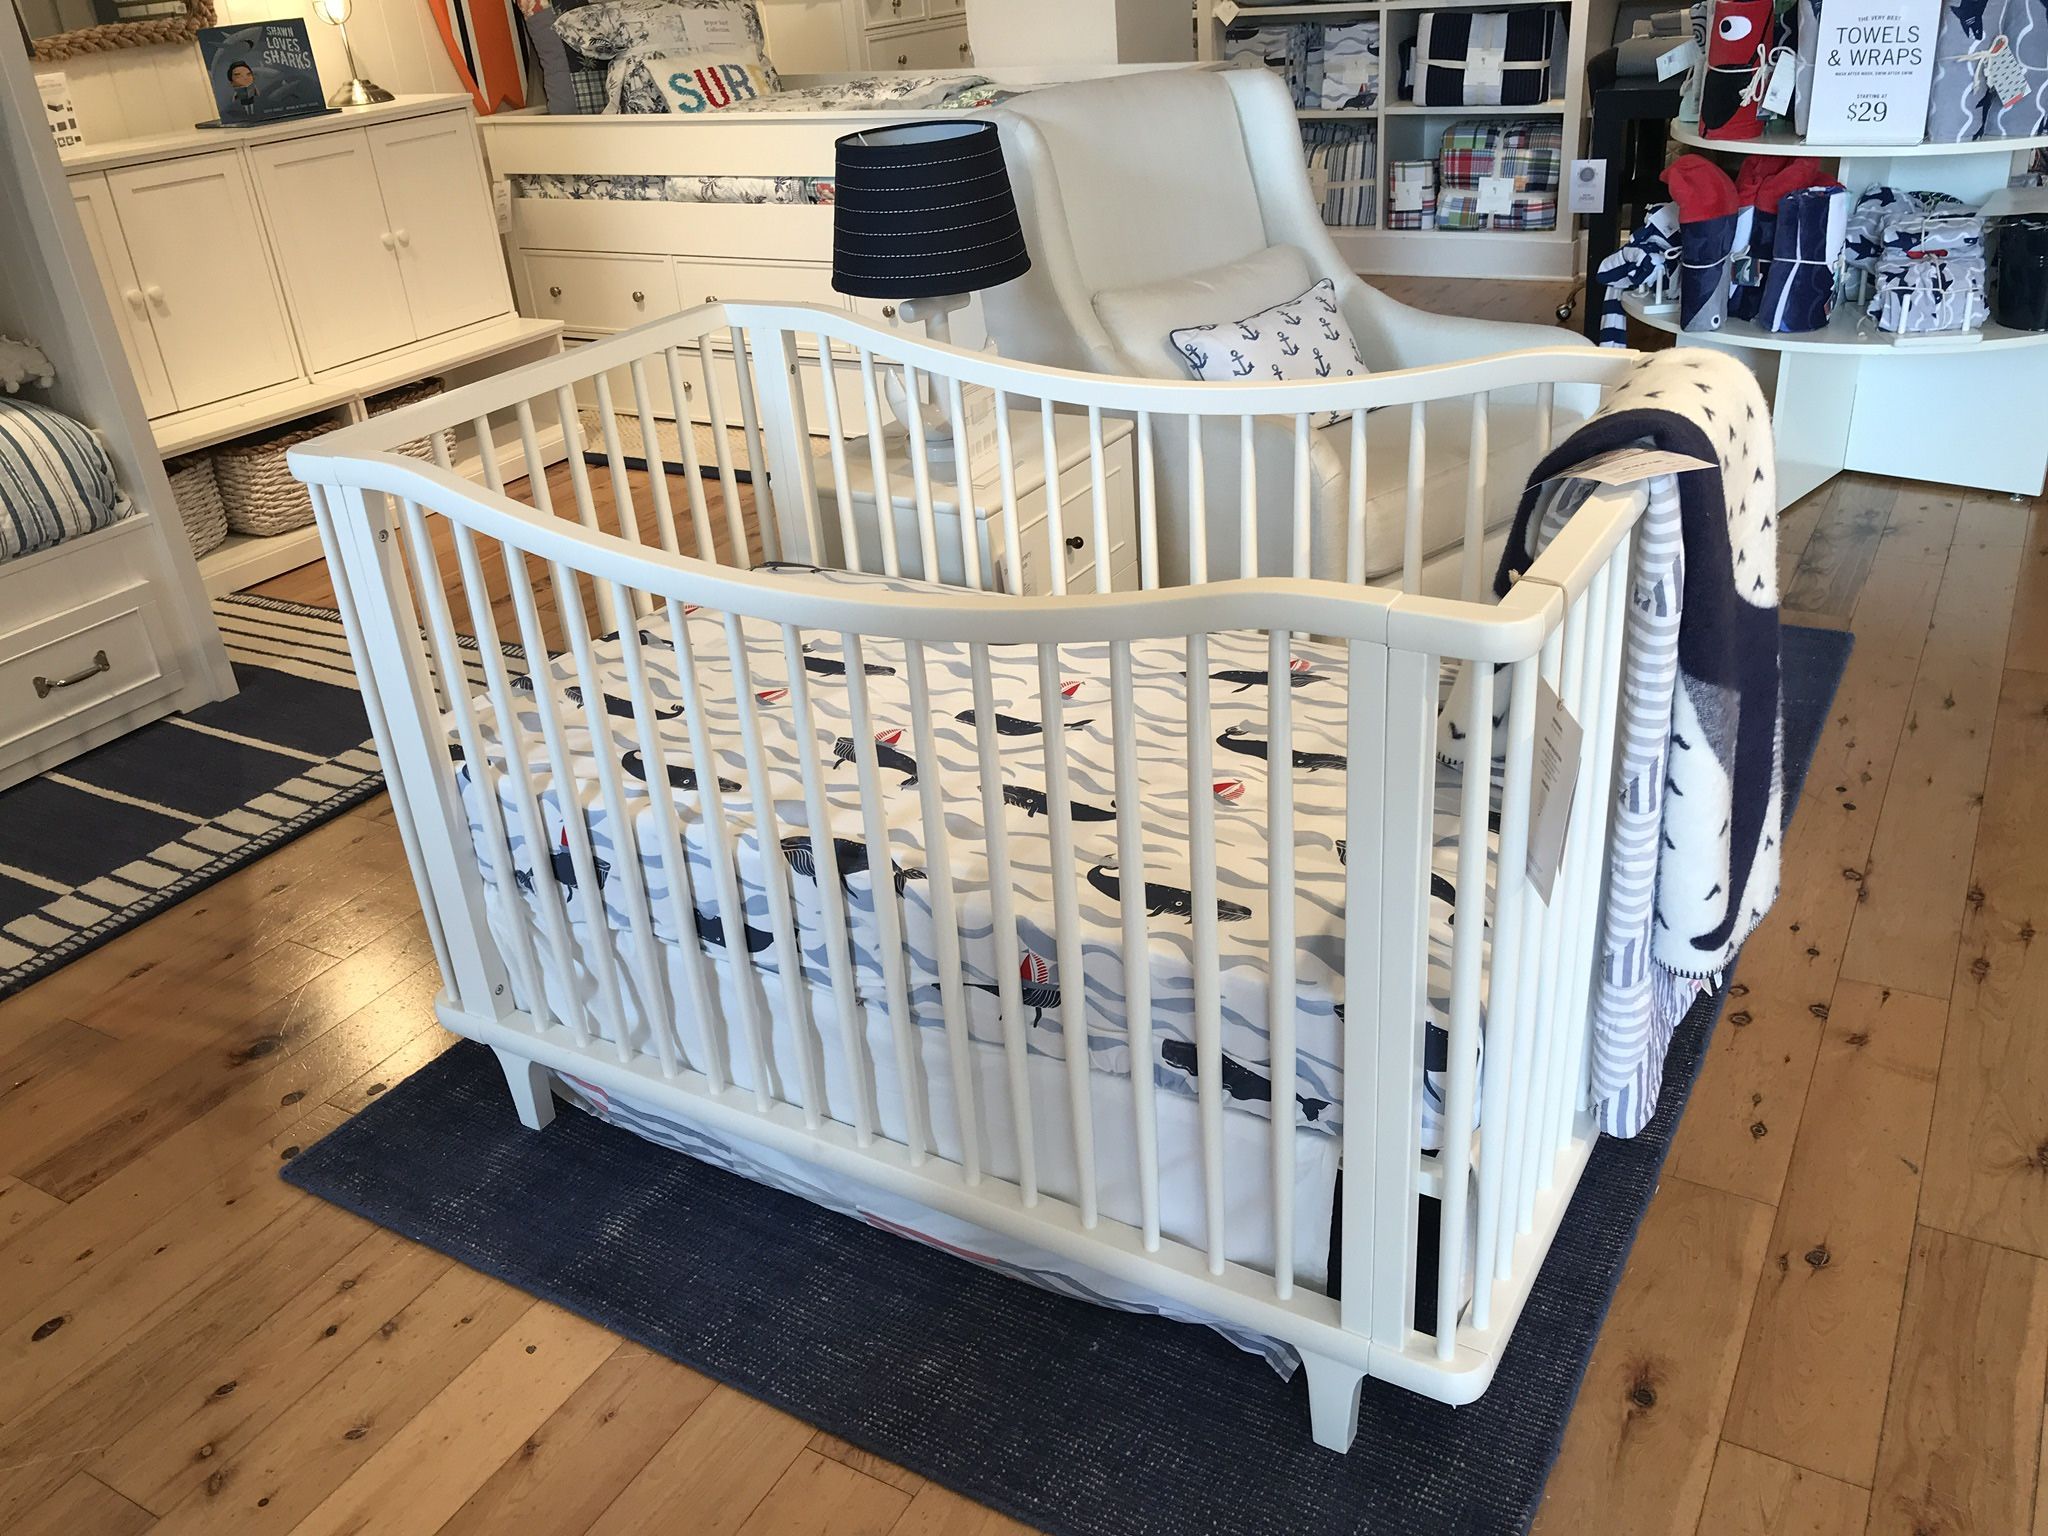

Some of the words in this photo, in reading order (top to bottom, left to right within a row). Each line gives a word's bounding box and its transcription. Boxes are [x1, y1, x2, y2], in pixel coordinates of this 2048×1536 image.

[266, 26, 294, 37] SHAWN
[1836, 25, 1920, 44] TOWELS
[266, 37, 300, 51] LOVES
[263, 50, 311, 69] SHARKS
[1827, 49, 1841, 67] &
[1850, 48, 1922, 66] WRAPS
[1847, 101, 1888, 122] $29
